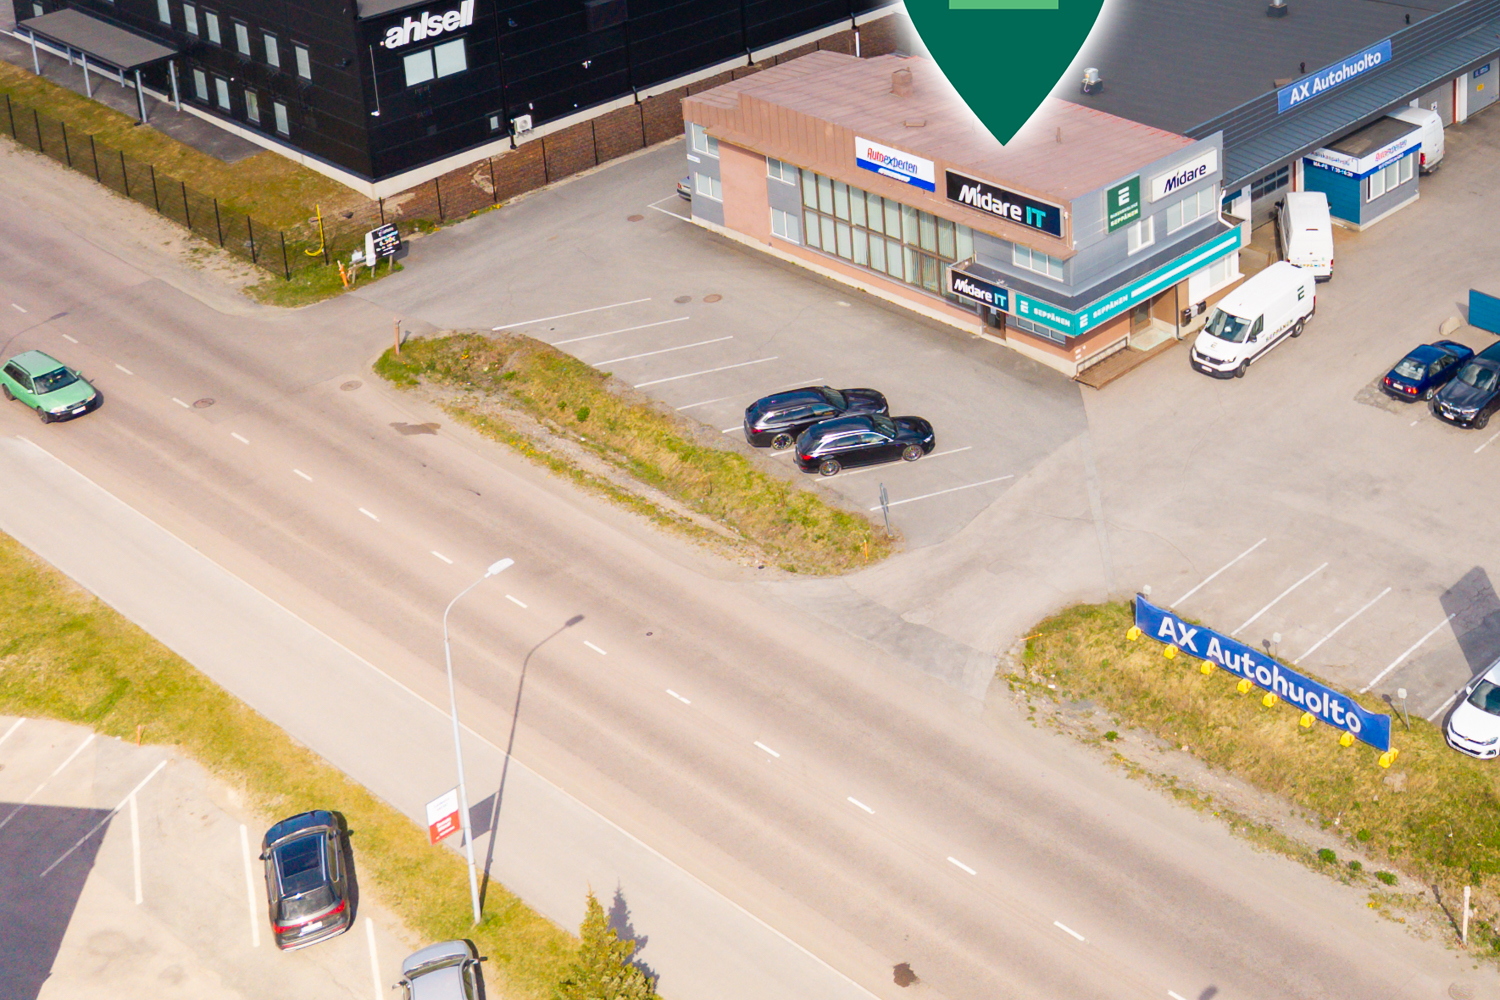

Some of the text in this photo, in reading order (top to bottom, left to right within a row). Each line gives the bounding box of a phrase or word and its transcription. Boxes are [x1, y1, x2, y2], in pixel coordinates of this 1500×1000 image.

[1290, 52, 1381, 105] AX Autohuolto
[867, 147, 918, 174] Autoexperten
[1164, 164, 1207, 194] Midare
[958, 184, 1046, 228] Midare IT
[954, 279, 1007, 307] Midare IT
[1157, 616, 1361, 733] AX Autohuolto
